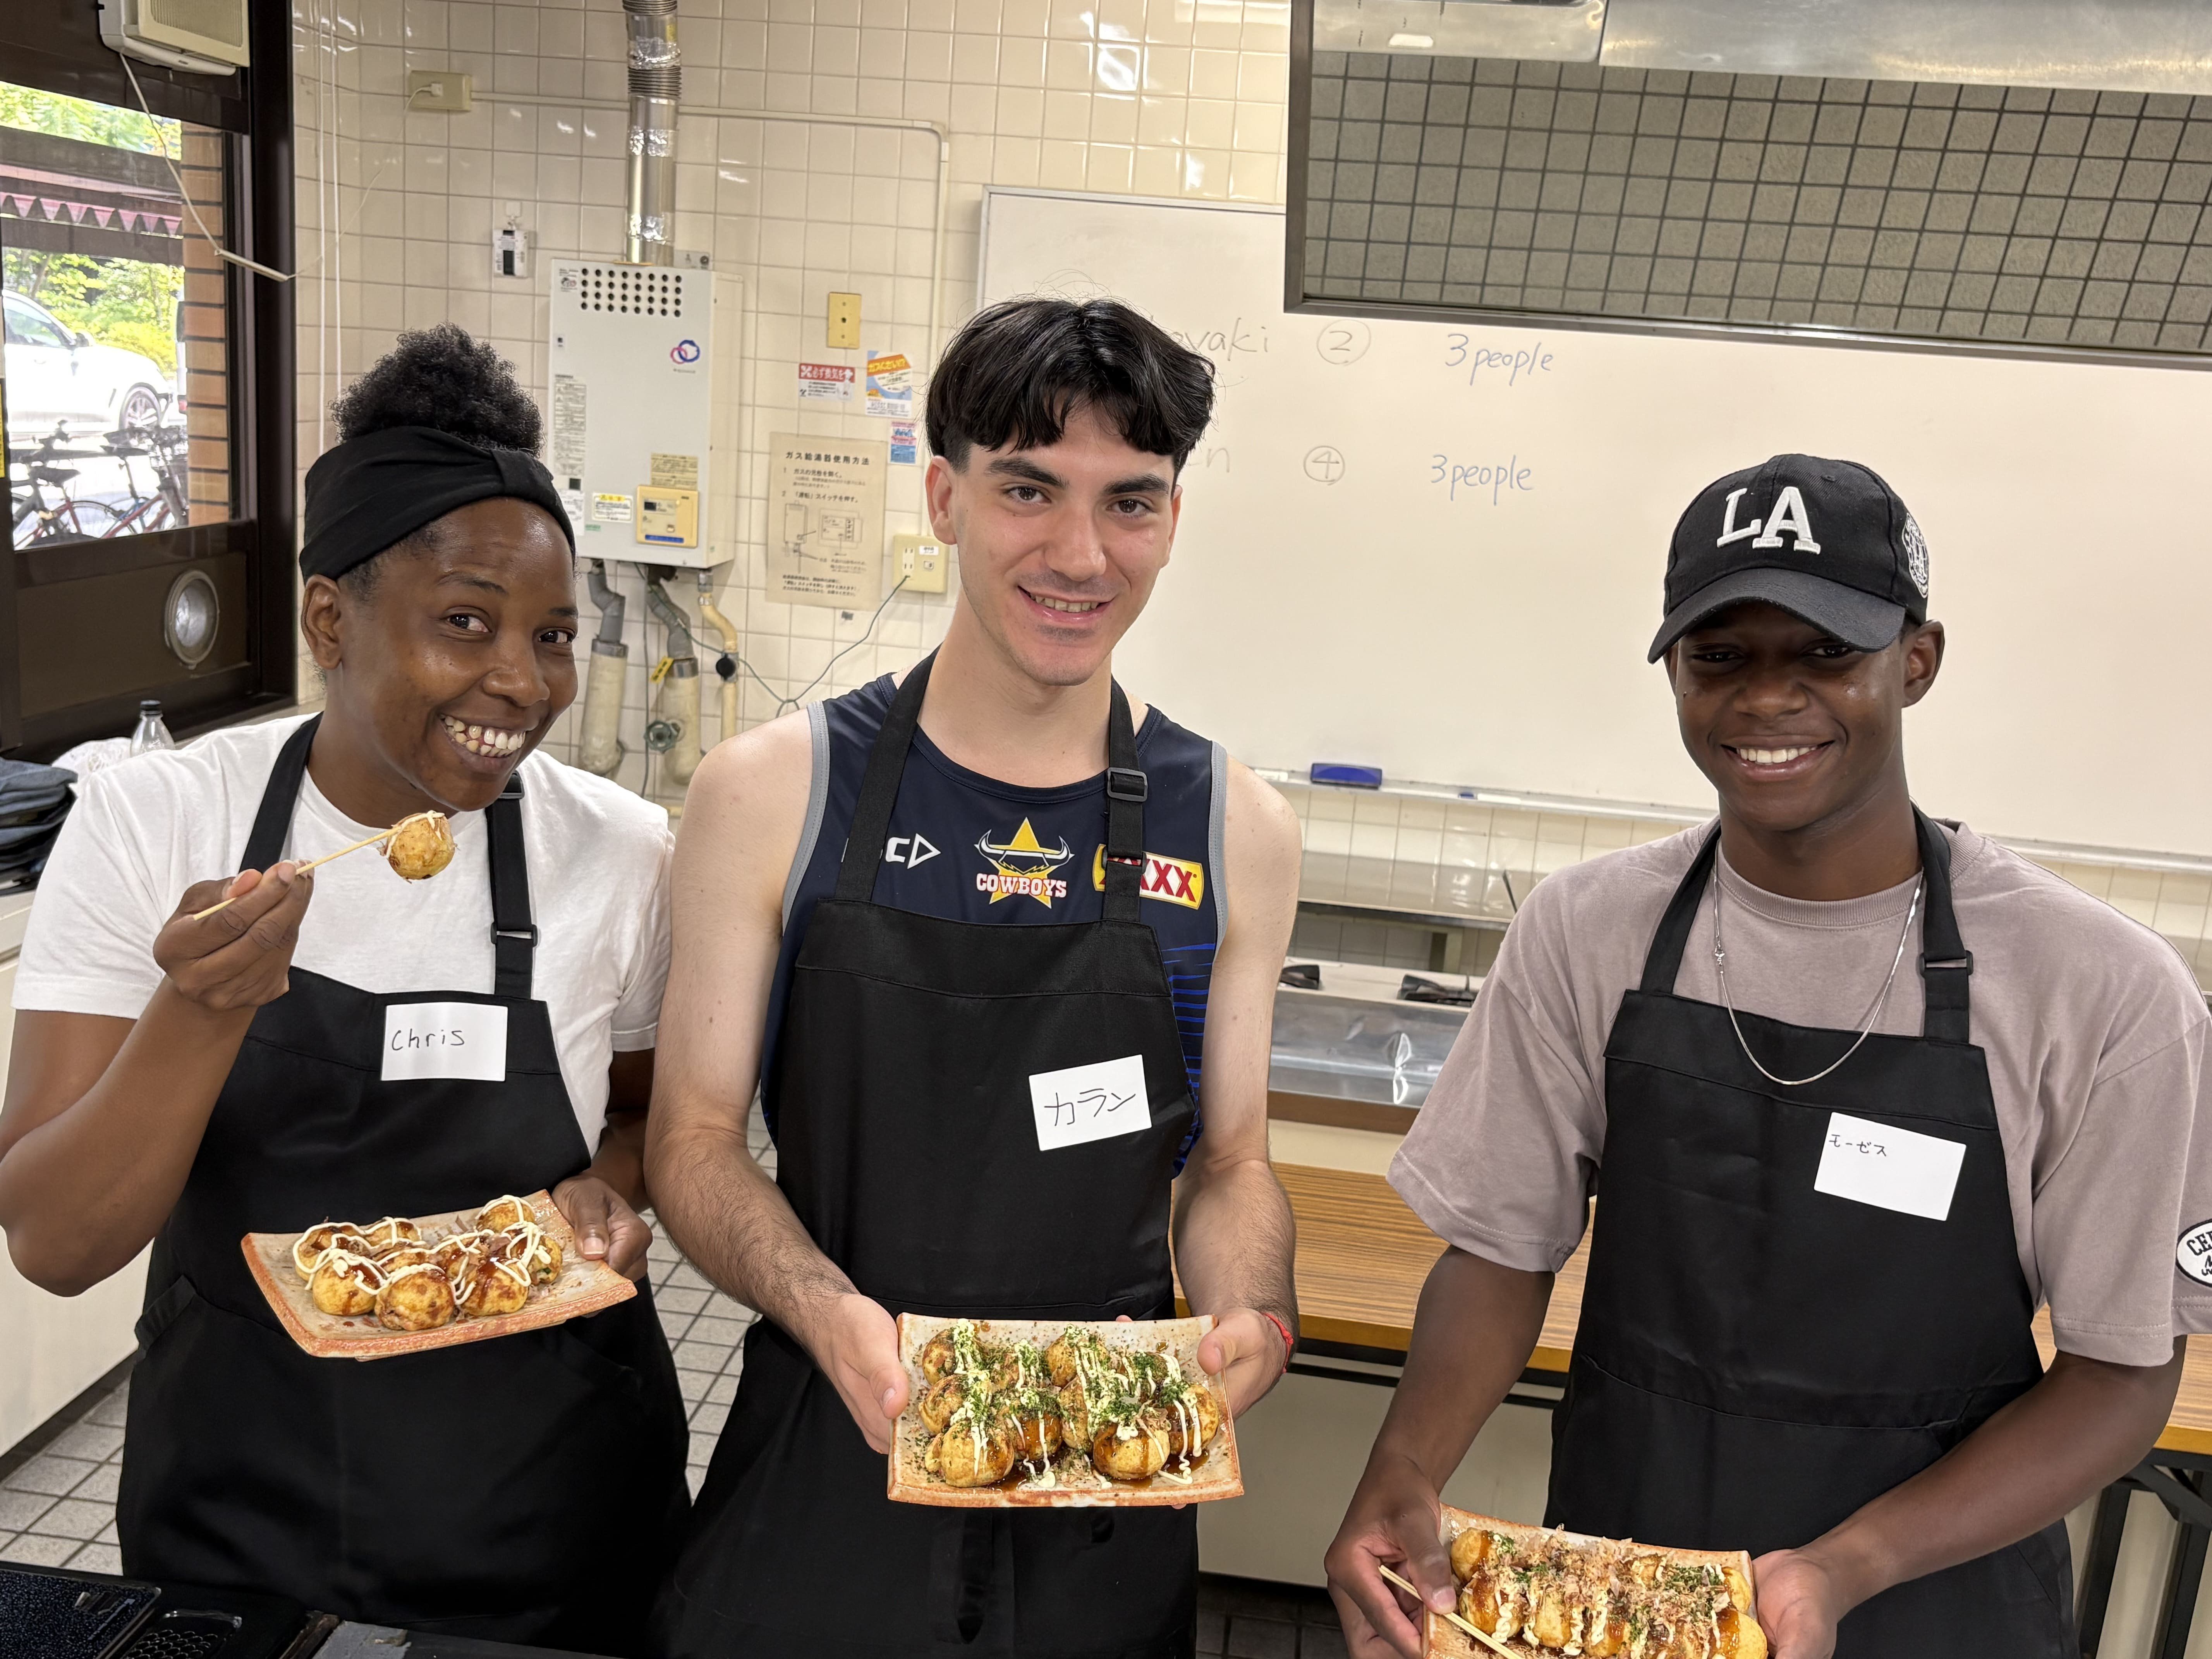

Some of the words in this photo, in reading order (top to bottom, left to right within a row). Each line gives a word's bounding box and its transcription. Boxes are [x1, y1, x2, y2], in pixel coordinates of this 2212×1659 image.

[1717, 486, 1821, 555] LA
[976, 872, 1068, 898] COWBOYS
[392, 1028, 465, 1051] Chris
[1044, 1088, 1136, 1127] カラン
[1829, 1134, 1887, 1157] モーゼス
